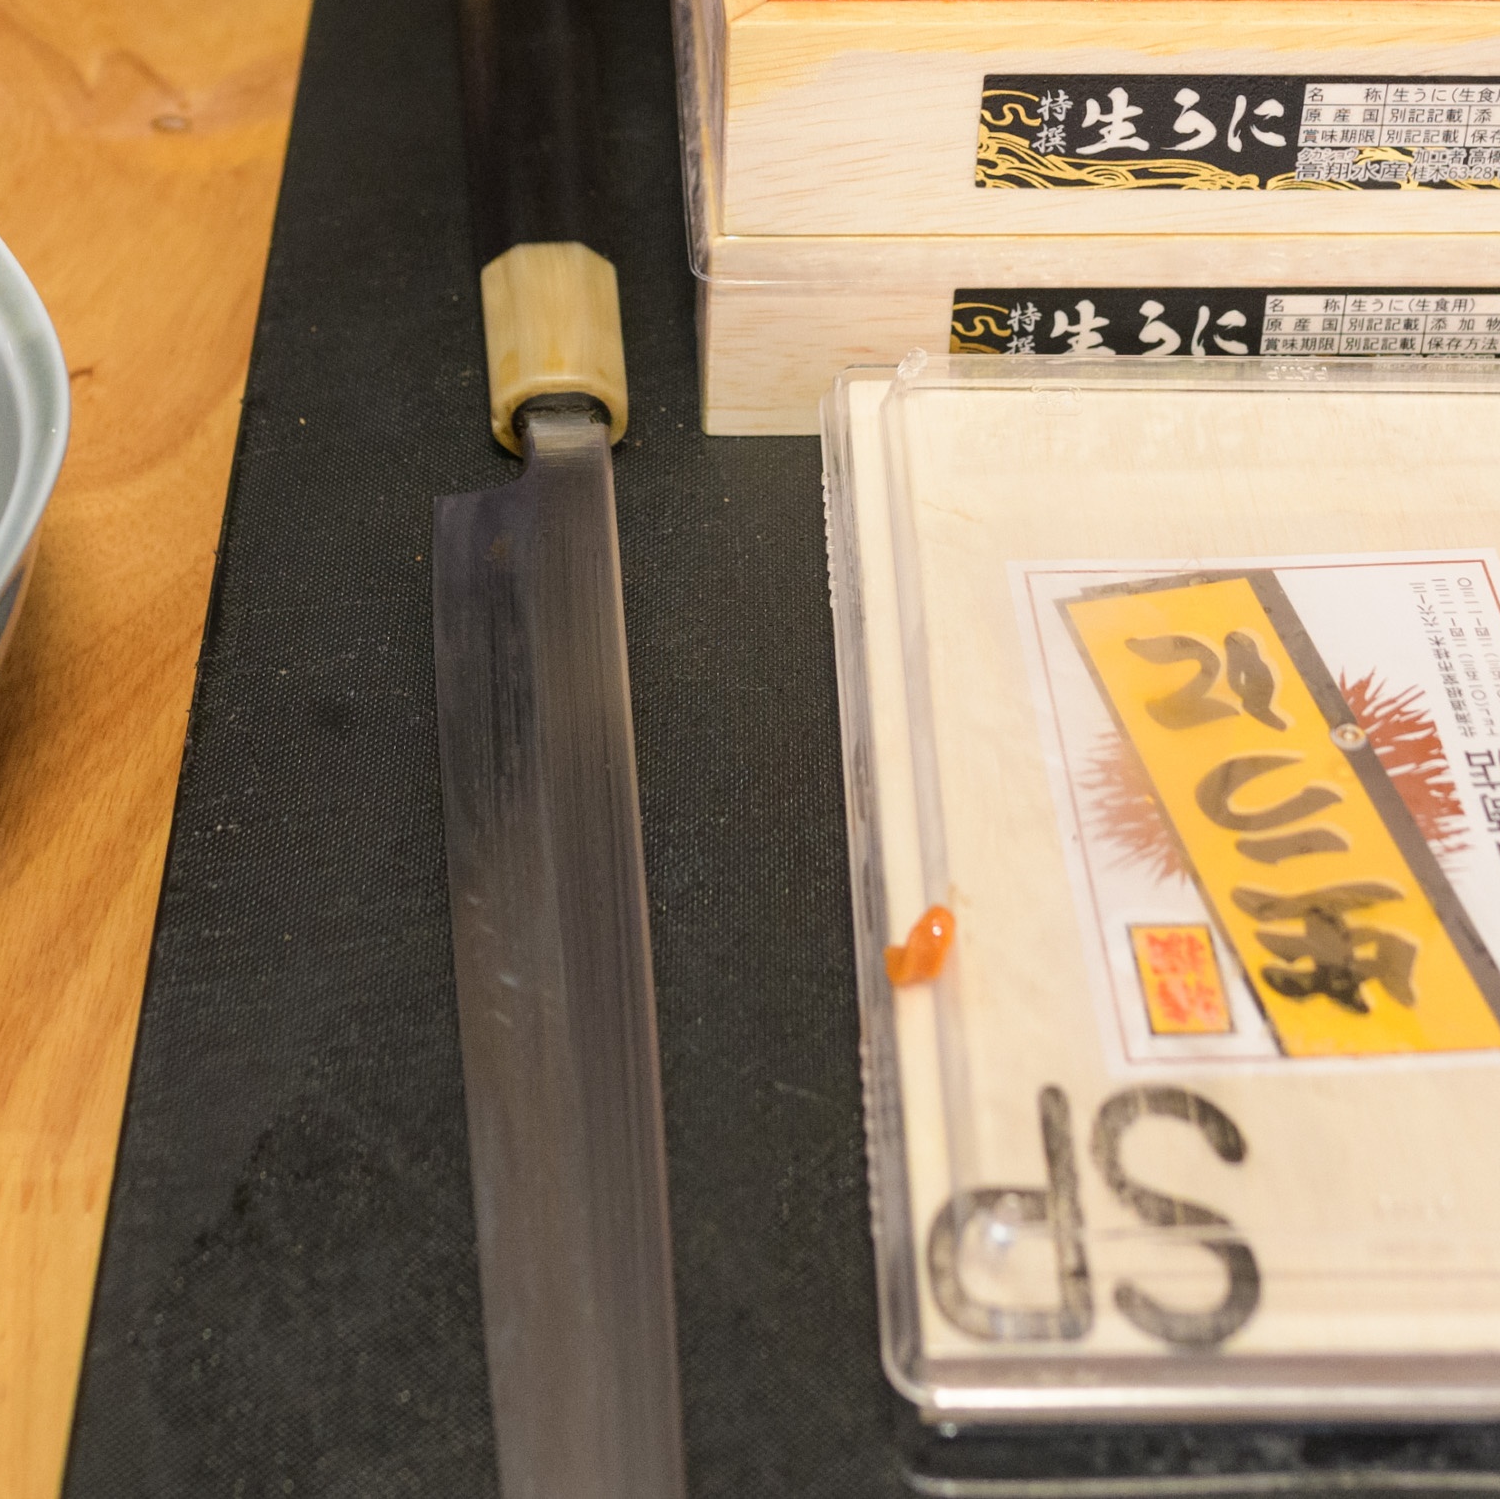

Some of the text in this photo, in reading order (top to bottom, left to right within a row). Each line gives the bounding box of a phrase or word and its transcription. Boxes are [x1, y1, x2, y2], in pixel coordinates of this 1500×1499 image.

[1031, 89, 1074, 154] 特撰
[1076, 87, 1286, 152] 生うに
[1303, 108, 1379, 124] 原産国
[1388, 108, 1463, 124] 別記記載
[1301, 129, 1376, 144] 賞味期限
[1384, 129, 1459, 144] 別記記載
[1413, 149, 1466, 164] 加工者
[1350, 298, 1476, 313] 生うに(生食用)
[1051, 299, 1249, 356] 生うに
[1265, 317, 1338, 332] 原産国
[1347, 317, 1419, 332] 別記記載
[1263, 337, 1335, 352] 賞味期限
[1343, 337, 1416, 352] 別記記載
[1427, 337, 1499, 352] 保存方法
[1124, 630, 1419, 1016] 生うに
[927, 1084, 1263, 1348] SP
